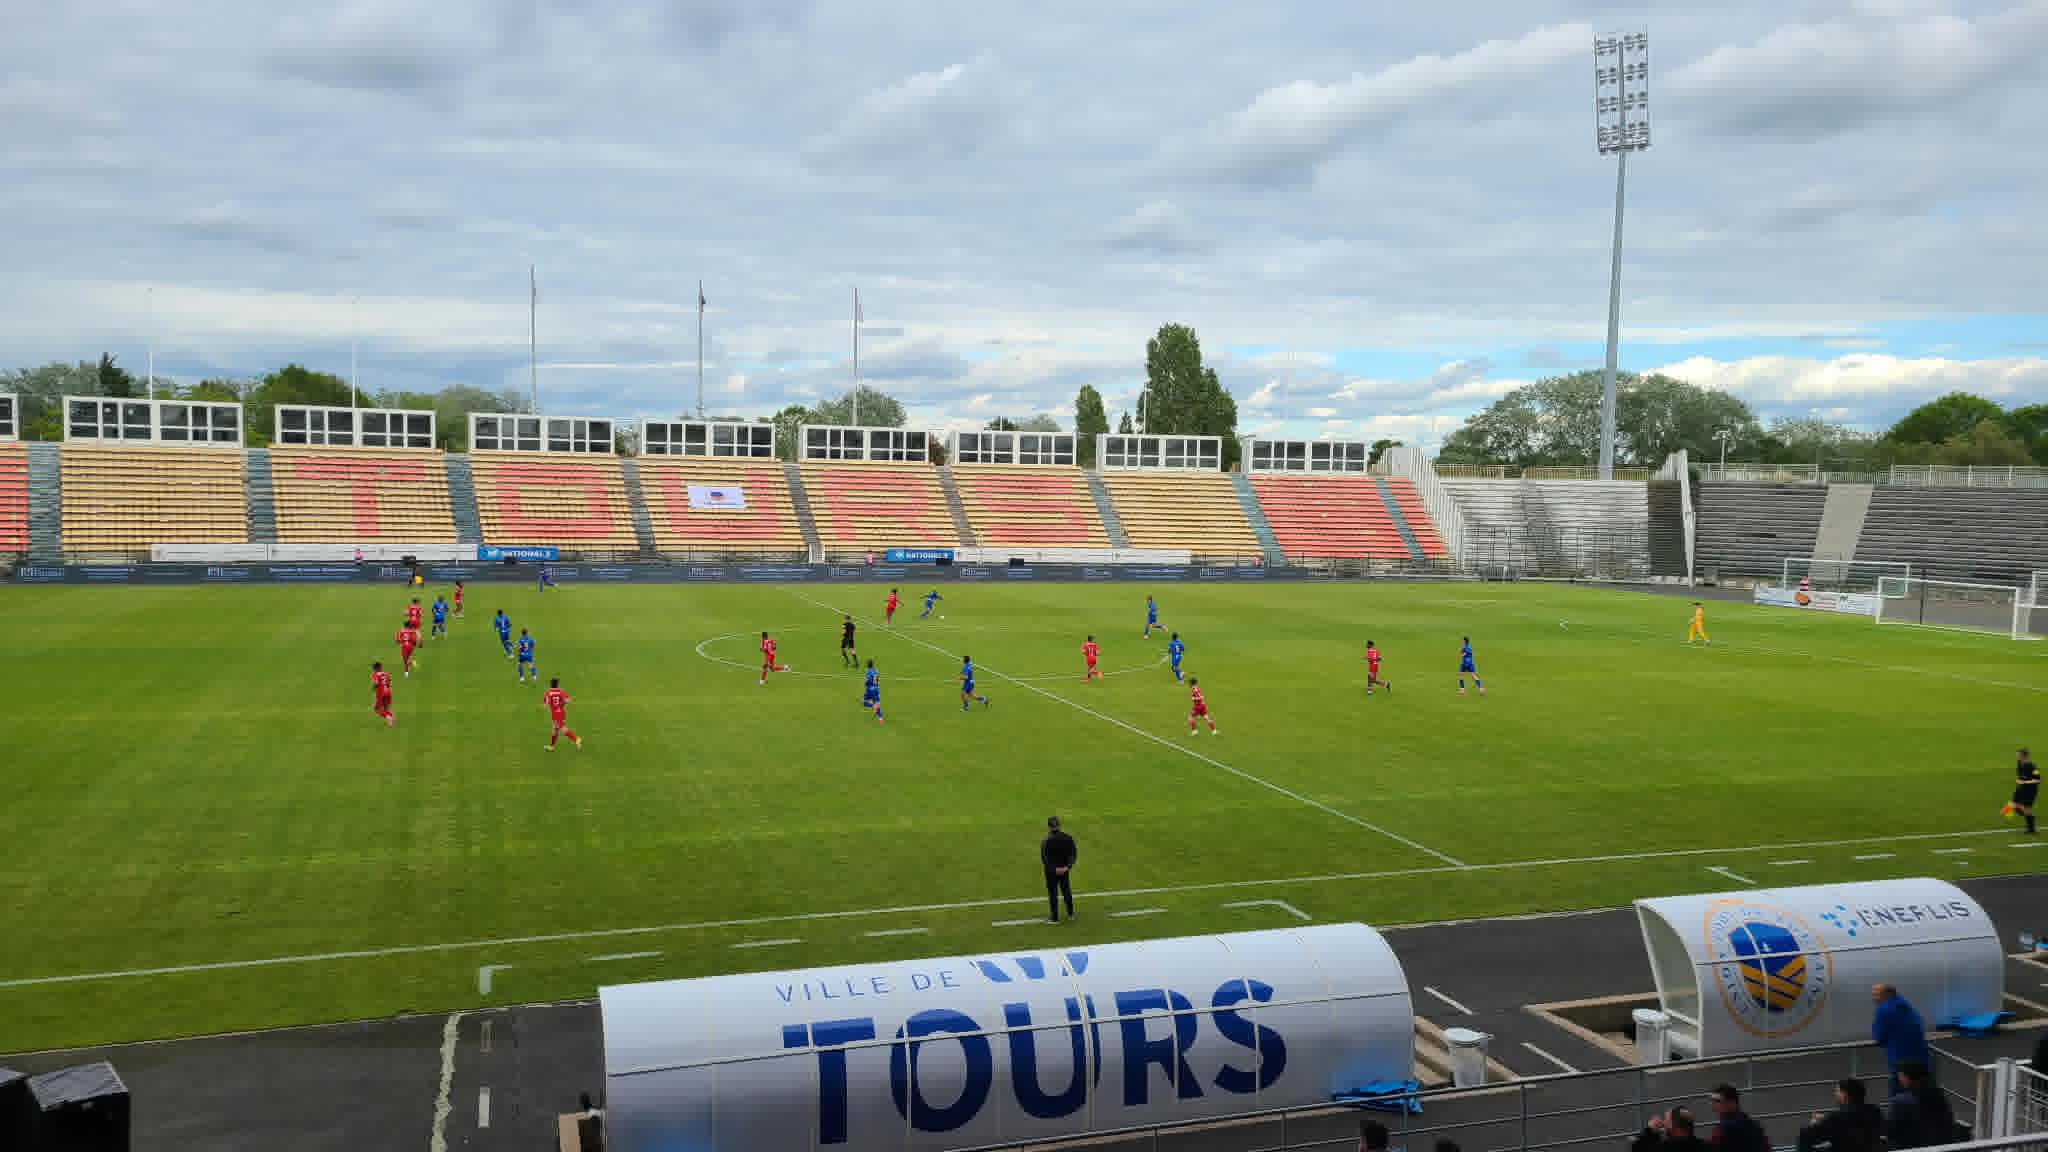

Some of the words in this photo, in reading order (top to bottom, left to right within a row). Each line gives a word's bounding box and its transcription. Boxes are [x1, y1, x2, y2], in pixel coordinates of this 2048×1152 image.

[776, 976, 889, 1002] VILLE
[911, 970, 961, 992] DE
[782, 976, 1288, 1145] TOURS
